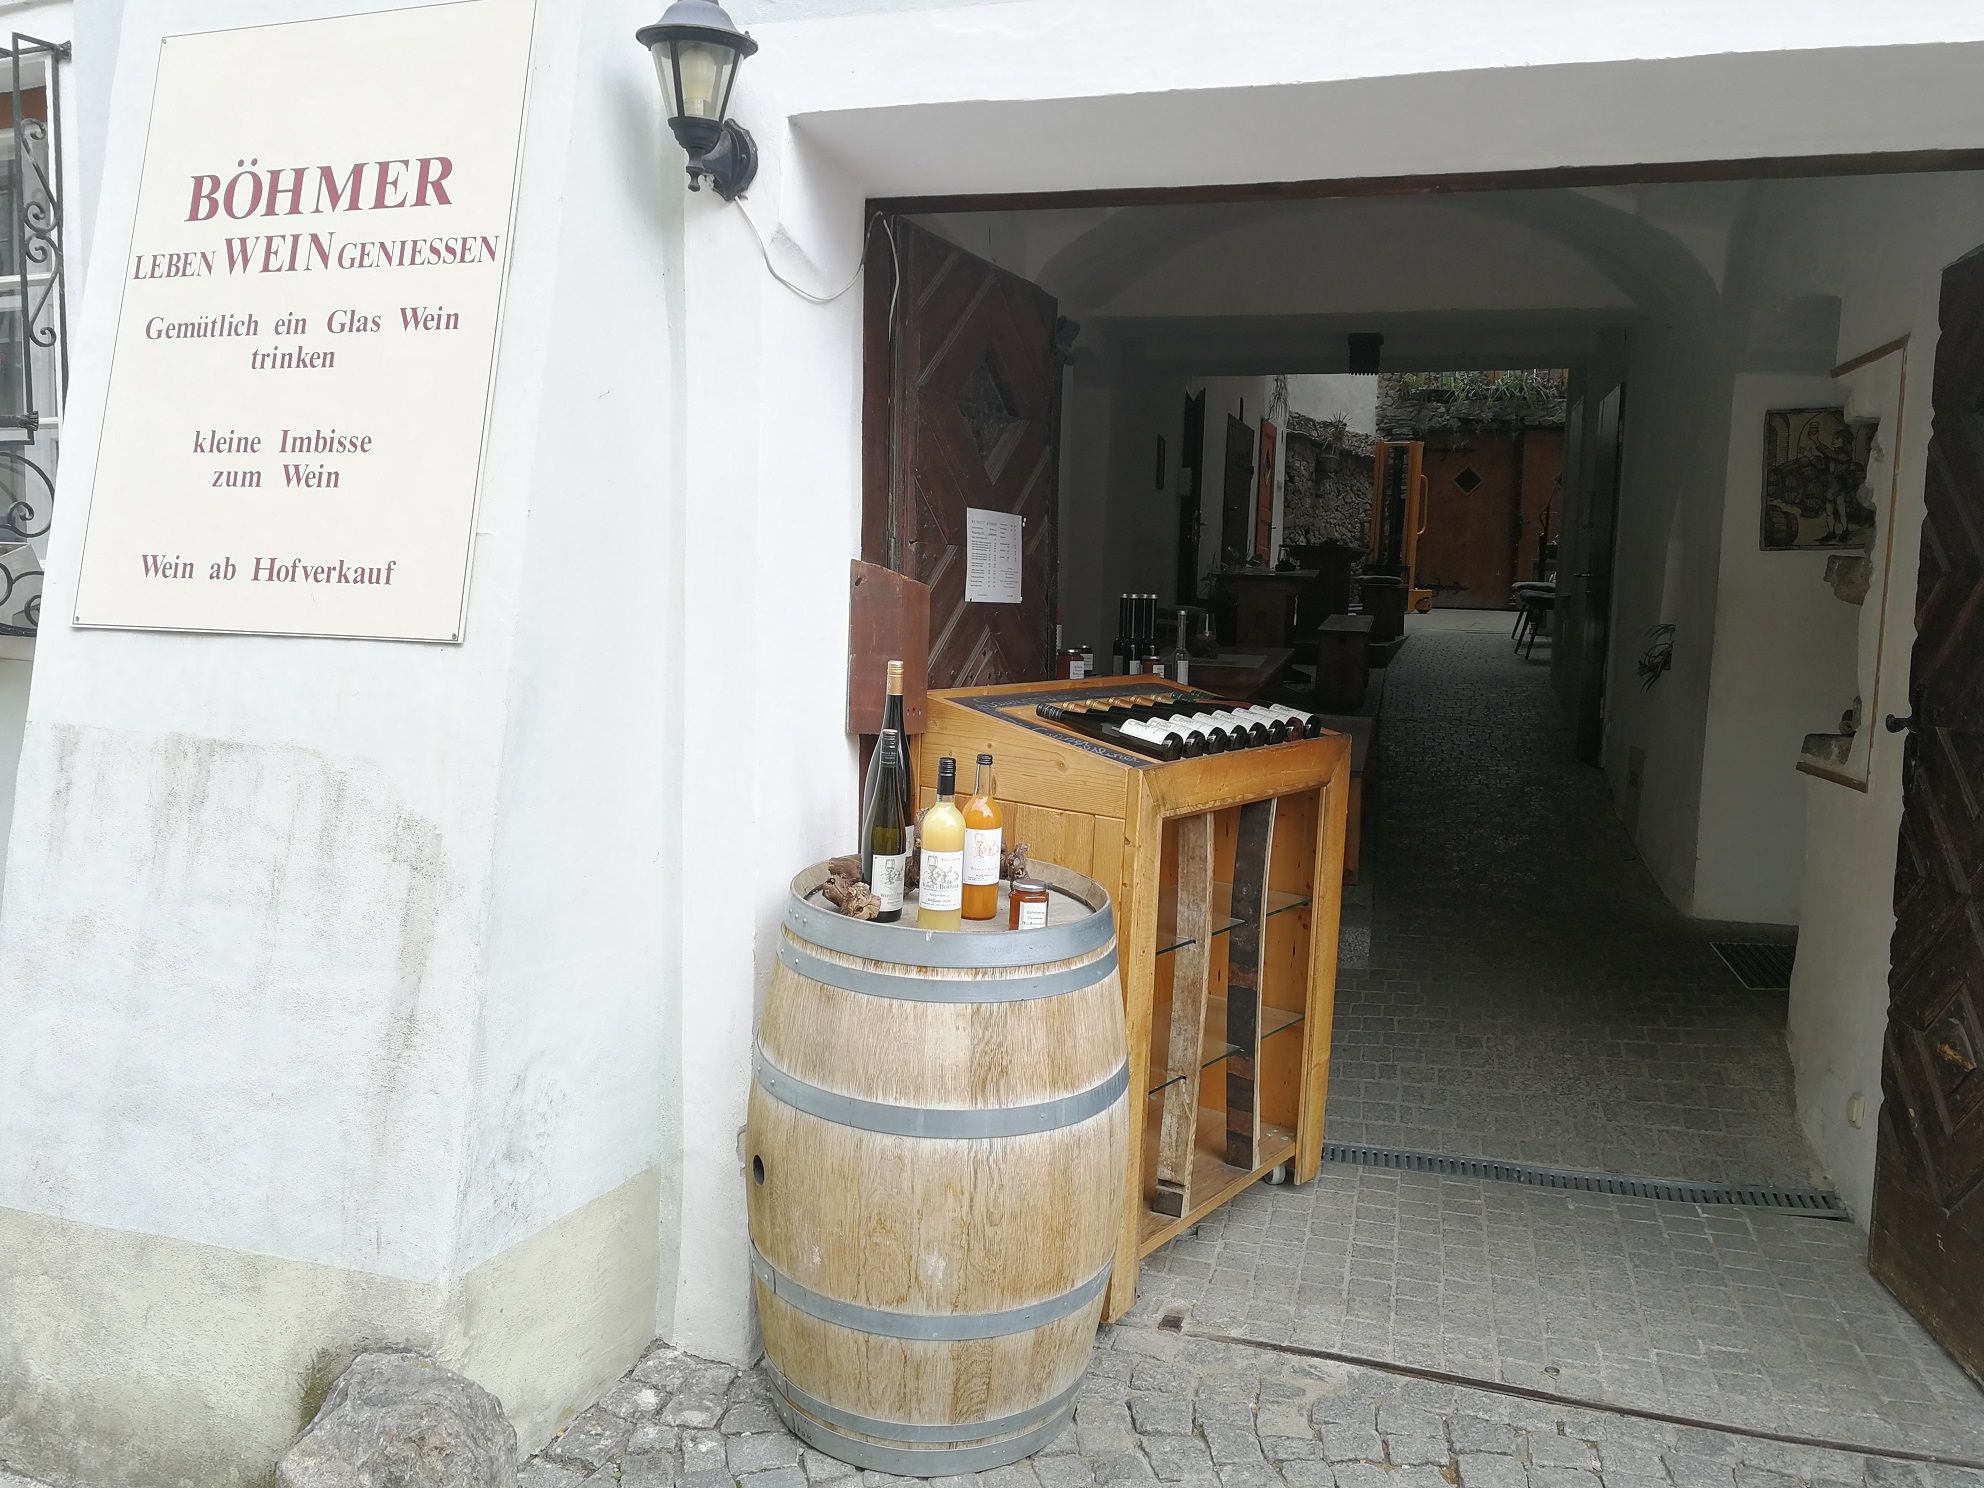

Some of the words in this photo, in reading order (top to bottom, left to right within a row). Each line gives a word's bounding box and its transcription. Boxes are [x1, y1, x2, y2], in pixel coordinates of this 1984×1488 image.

[183, 156, 453, 222] BÖHMER
[132, 251, 216, 280] LEBEN
[145, 312, 259, 340] Gemütlich
[273, 316, 308, 336] ein
[326, 309, 382, 334] Glas
[399, 306, 461, 331] Wein
[250, 345, 336, 370] trinken
[192, 429, 263, 454] kleine
[278, 429, 373, 454] Imbisse
[211, 470, 262, 488] zum
[282, 463, 340, 488] Wein
[141, 554, 194, 580] Wein
[208, 556, 237, 582] ab
[250, 556, 397, 586] Hofverkauf
